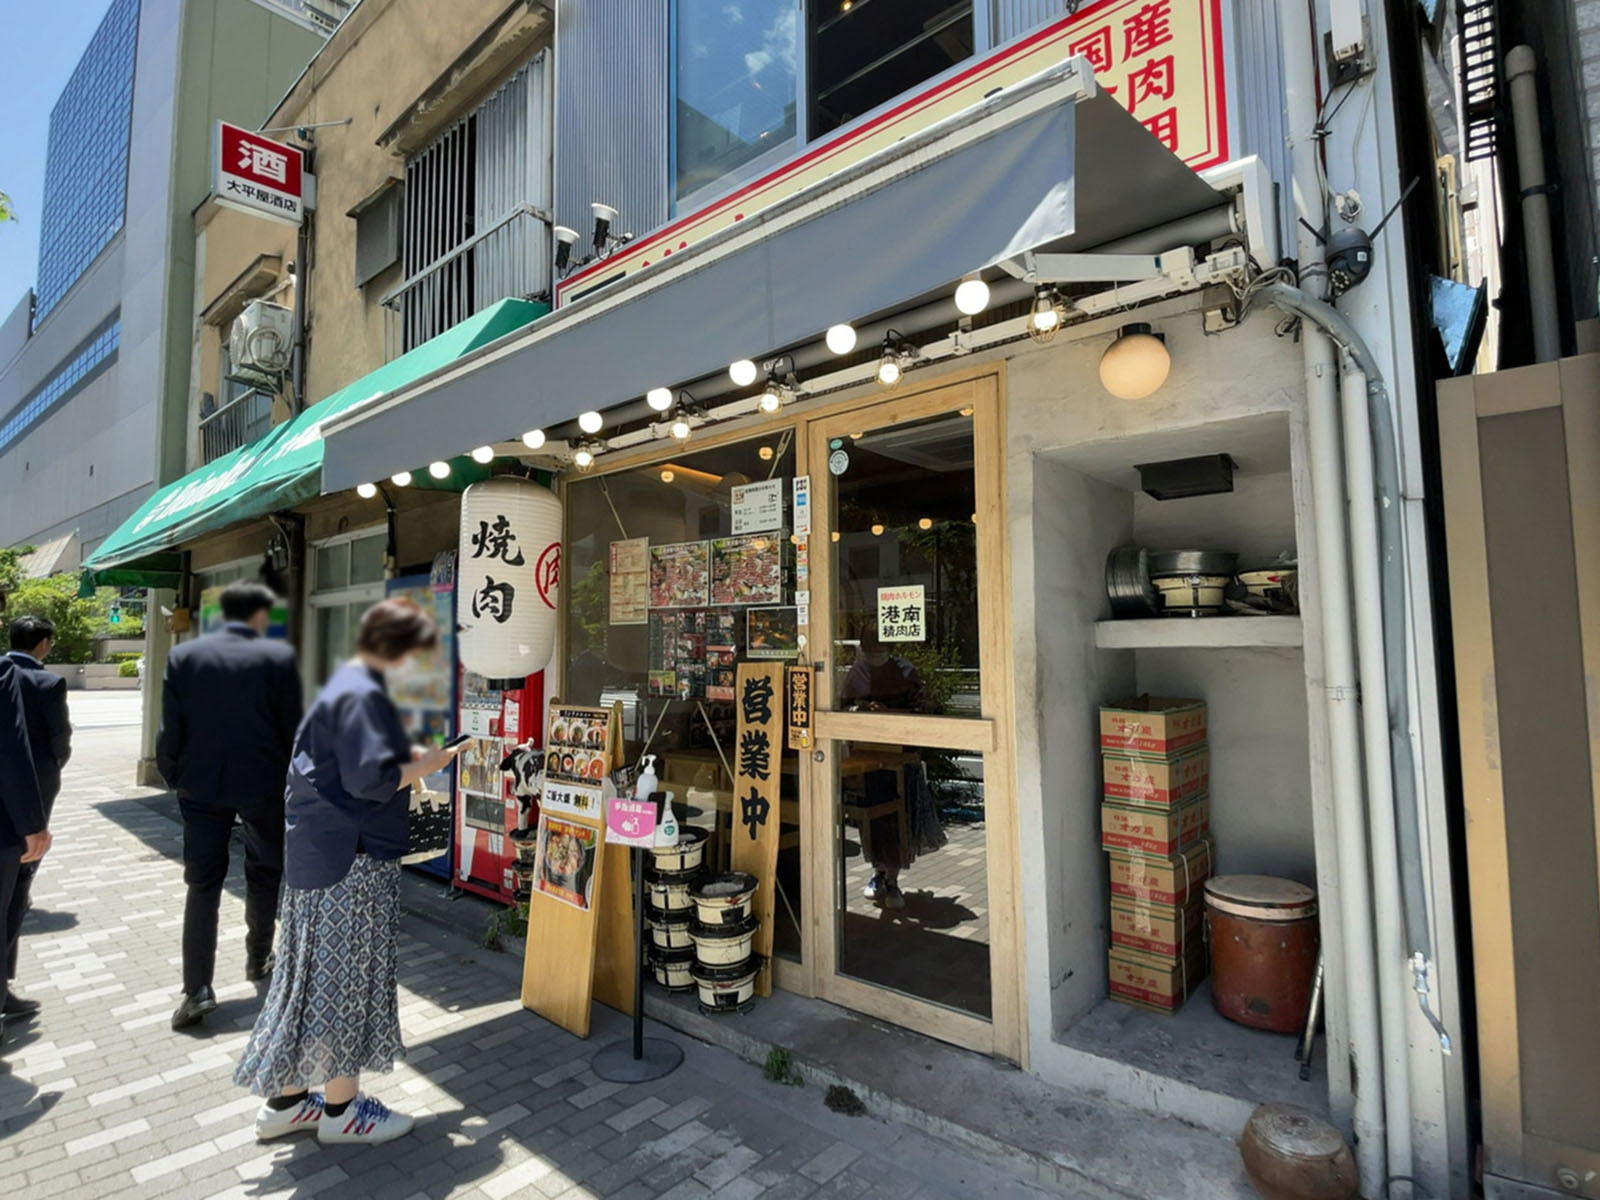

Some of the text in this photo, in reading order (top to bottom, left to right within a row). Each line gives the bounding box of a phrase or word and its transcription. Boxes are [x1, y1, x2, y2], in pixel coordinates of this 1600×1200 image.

[237, 139, 288, 185] 酒
[226, 179, 297, 213] 大平屋酒店
[471, 515, 525, 624] 焼肉
[881, 604, 921, 624] 港南
[883, 624, 921, 638] 精肉店
[791, 672, 808, 726] 営業中
[738, 675, 774, 841] 営業中
